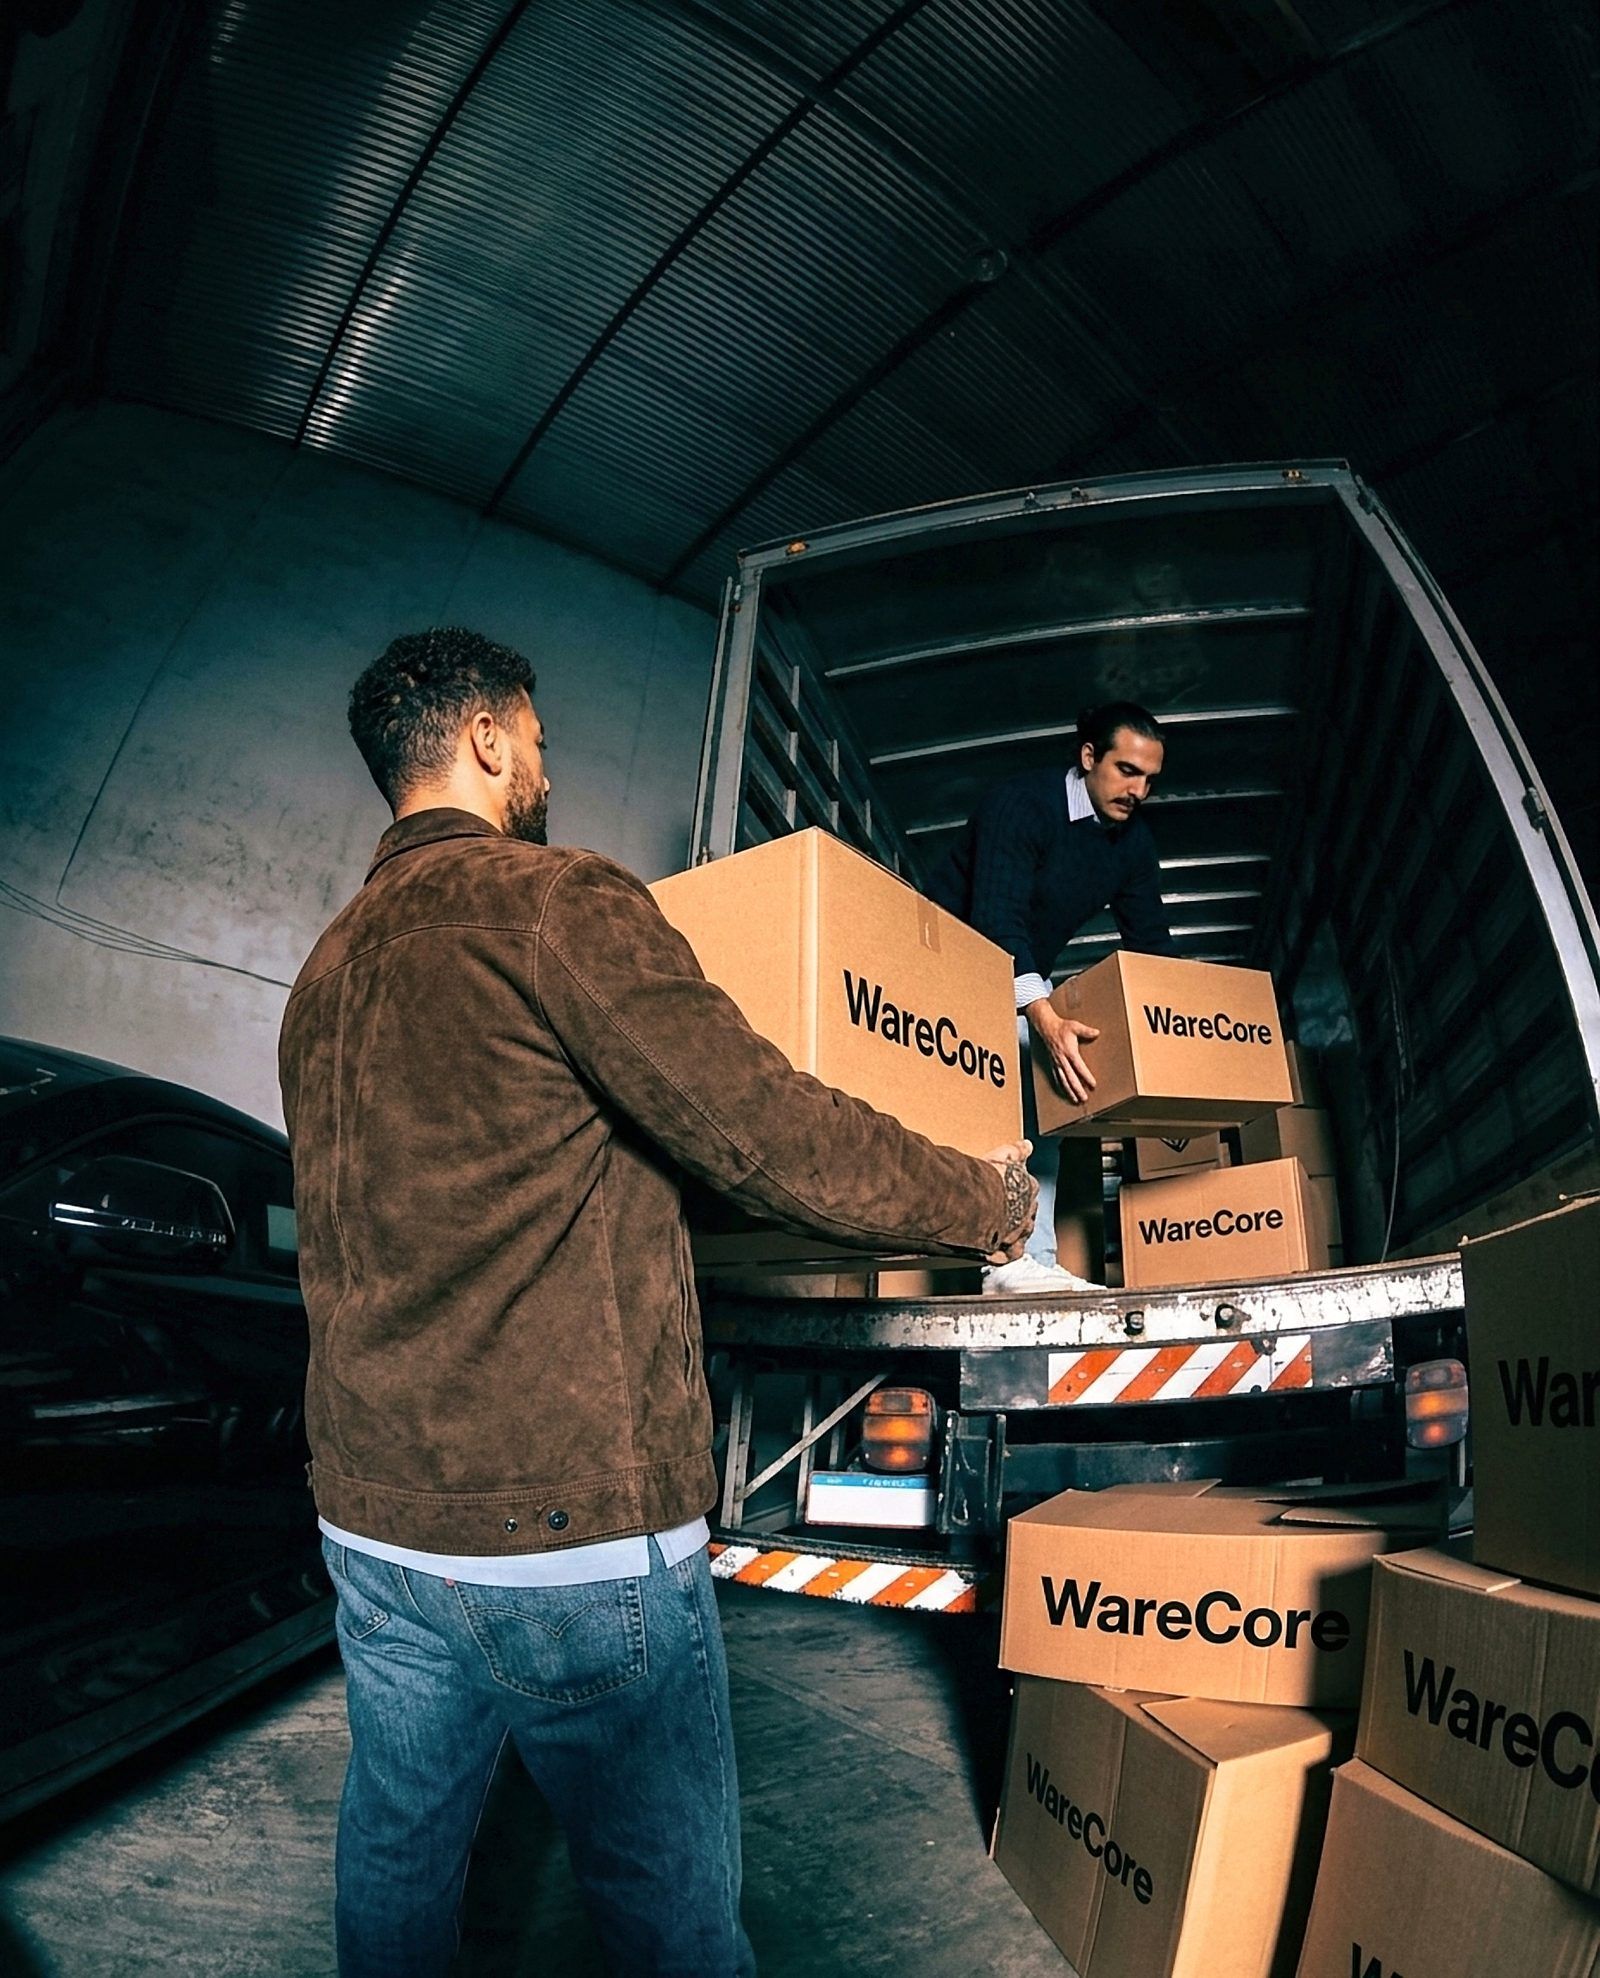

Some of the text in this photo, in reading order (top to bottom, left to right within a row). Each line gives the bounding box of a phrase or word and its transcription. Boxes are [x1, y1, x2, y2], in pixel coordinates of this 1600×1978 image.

[843, 969, 1006, 1088] WareCore
[1143, 1005, 1272, 1045] WareCore
[1138, 1209, 1283, 1245] WareCore
[1041, 1575, 1351, 1653] WareCore
[1403, 1649, 1600, 1807] WareC
[1026, 1752, 1153, 1905] WareCore
